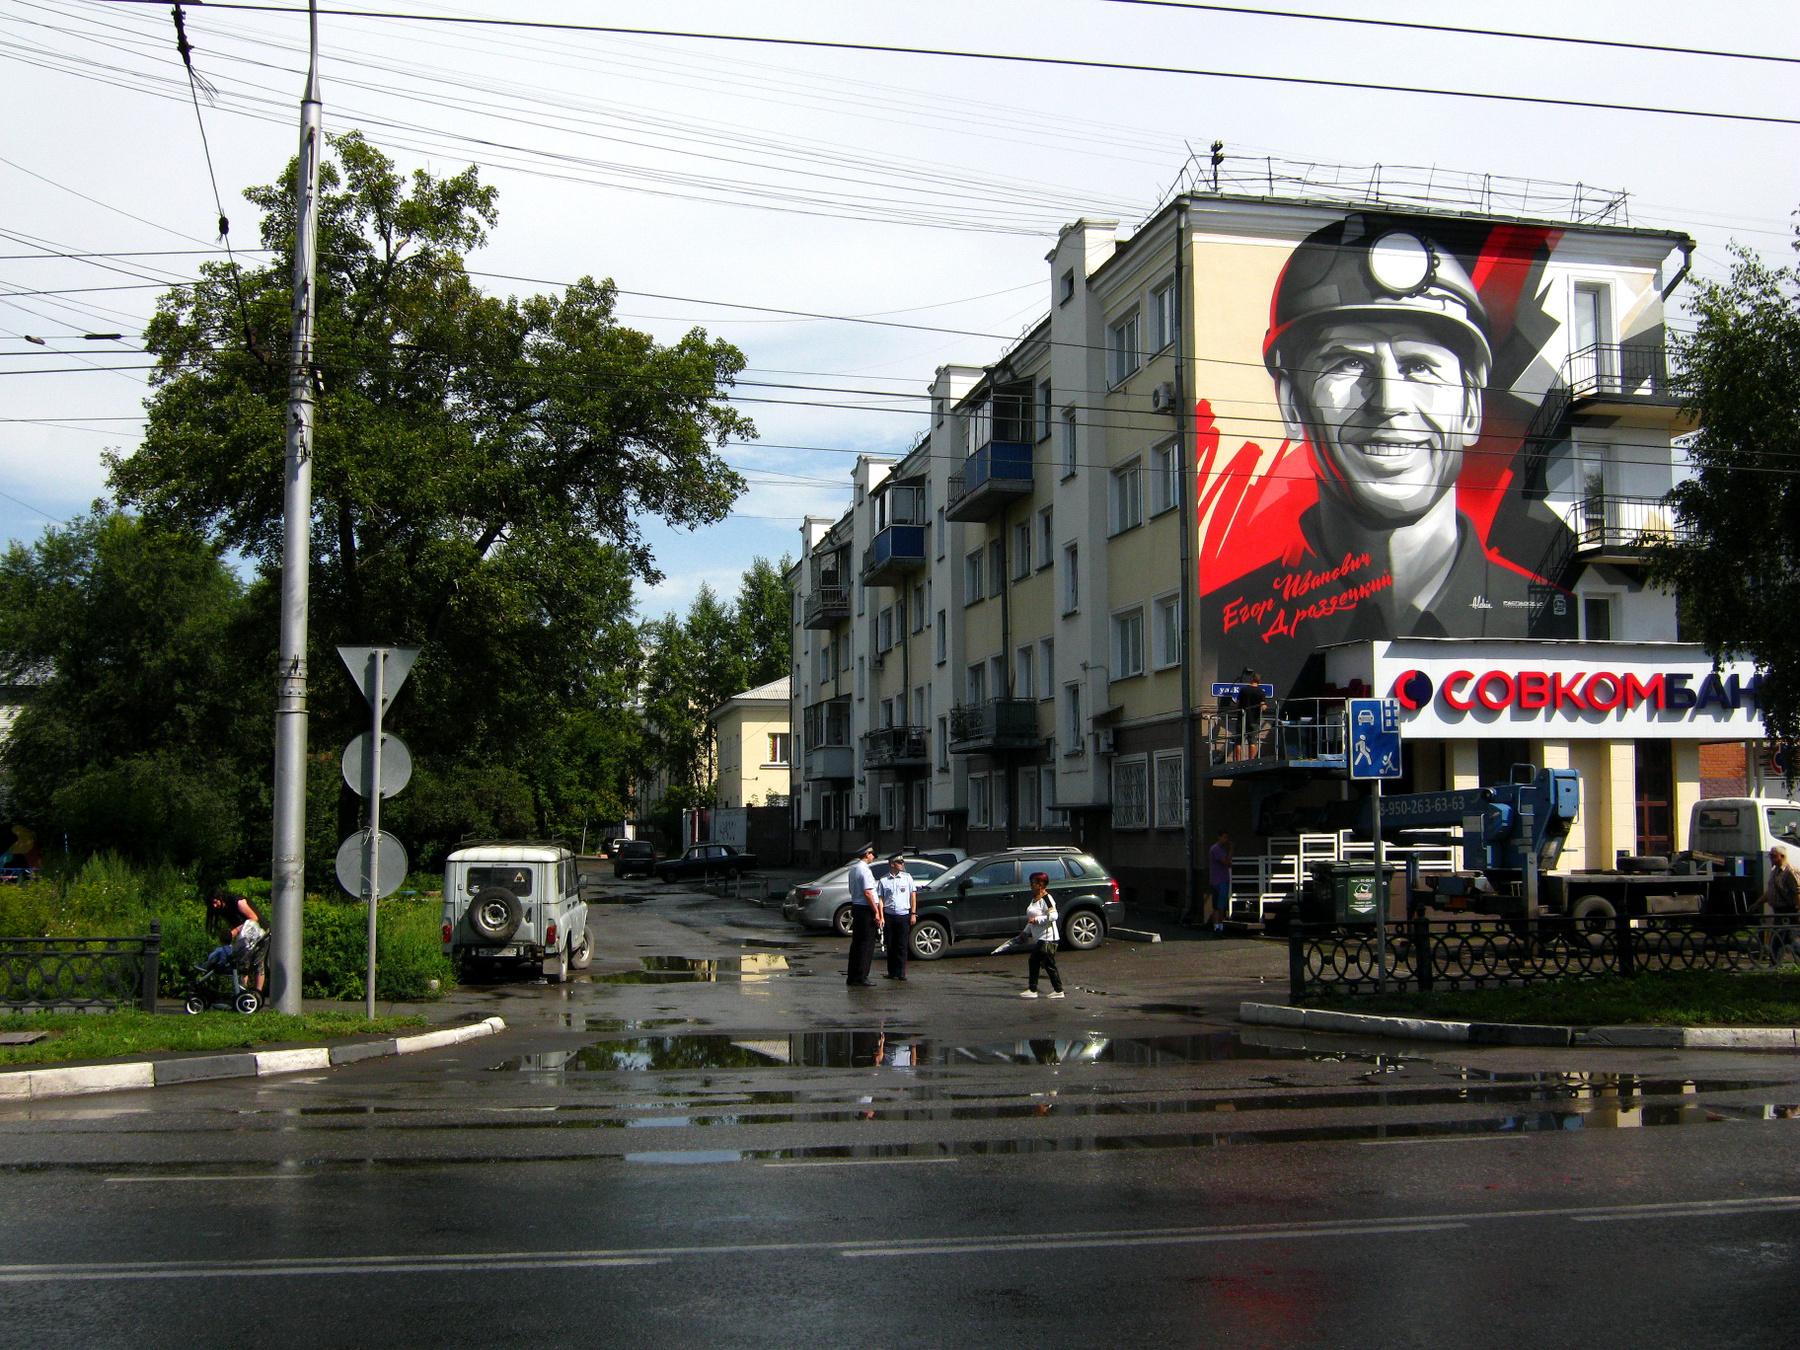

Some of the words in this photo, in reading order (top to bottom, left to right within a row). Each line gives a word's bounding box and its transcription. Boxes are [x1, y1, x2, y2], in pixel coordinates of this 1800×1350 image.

[1223, 596, 1274, 634] Егор
[1273, 553, 1371, 600] Иванович
[1443, 670, 1767, 712] СОВКОМБАН
